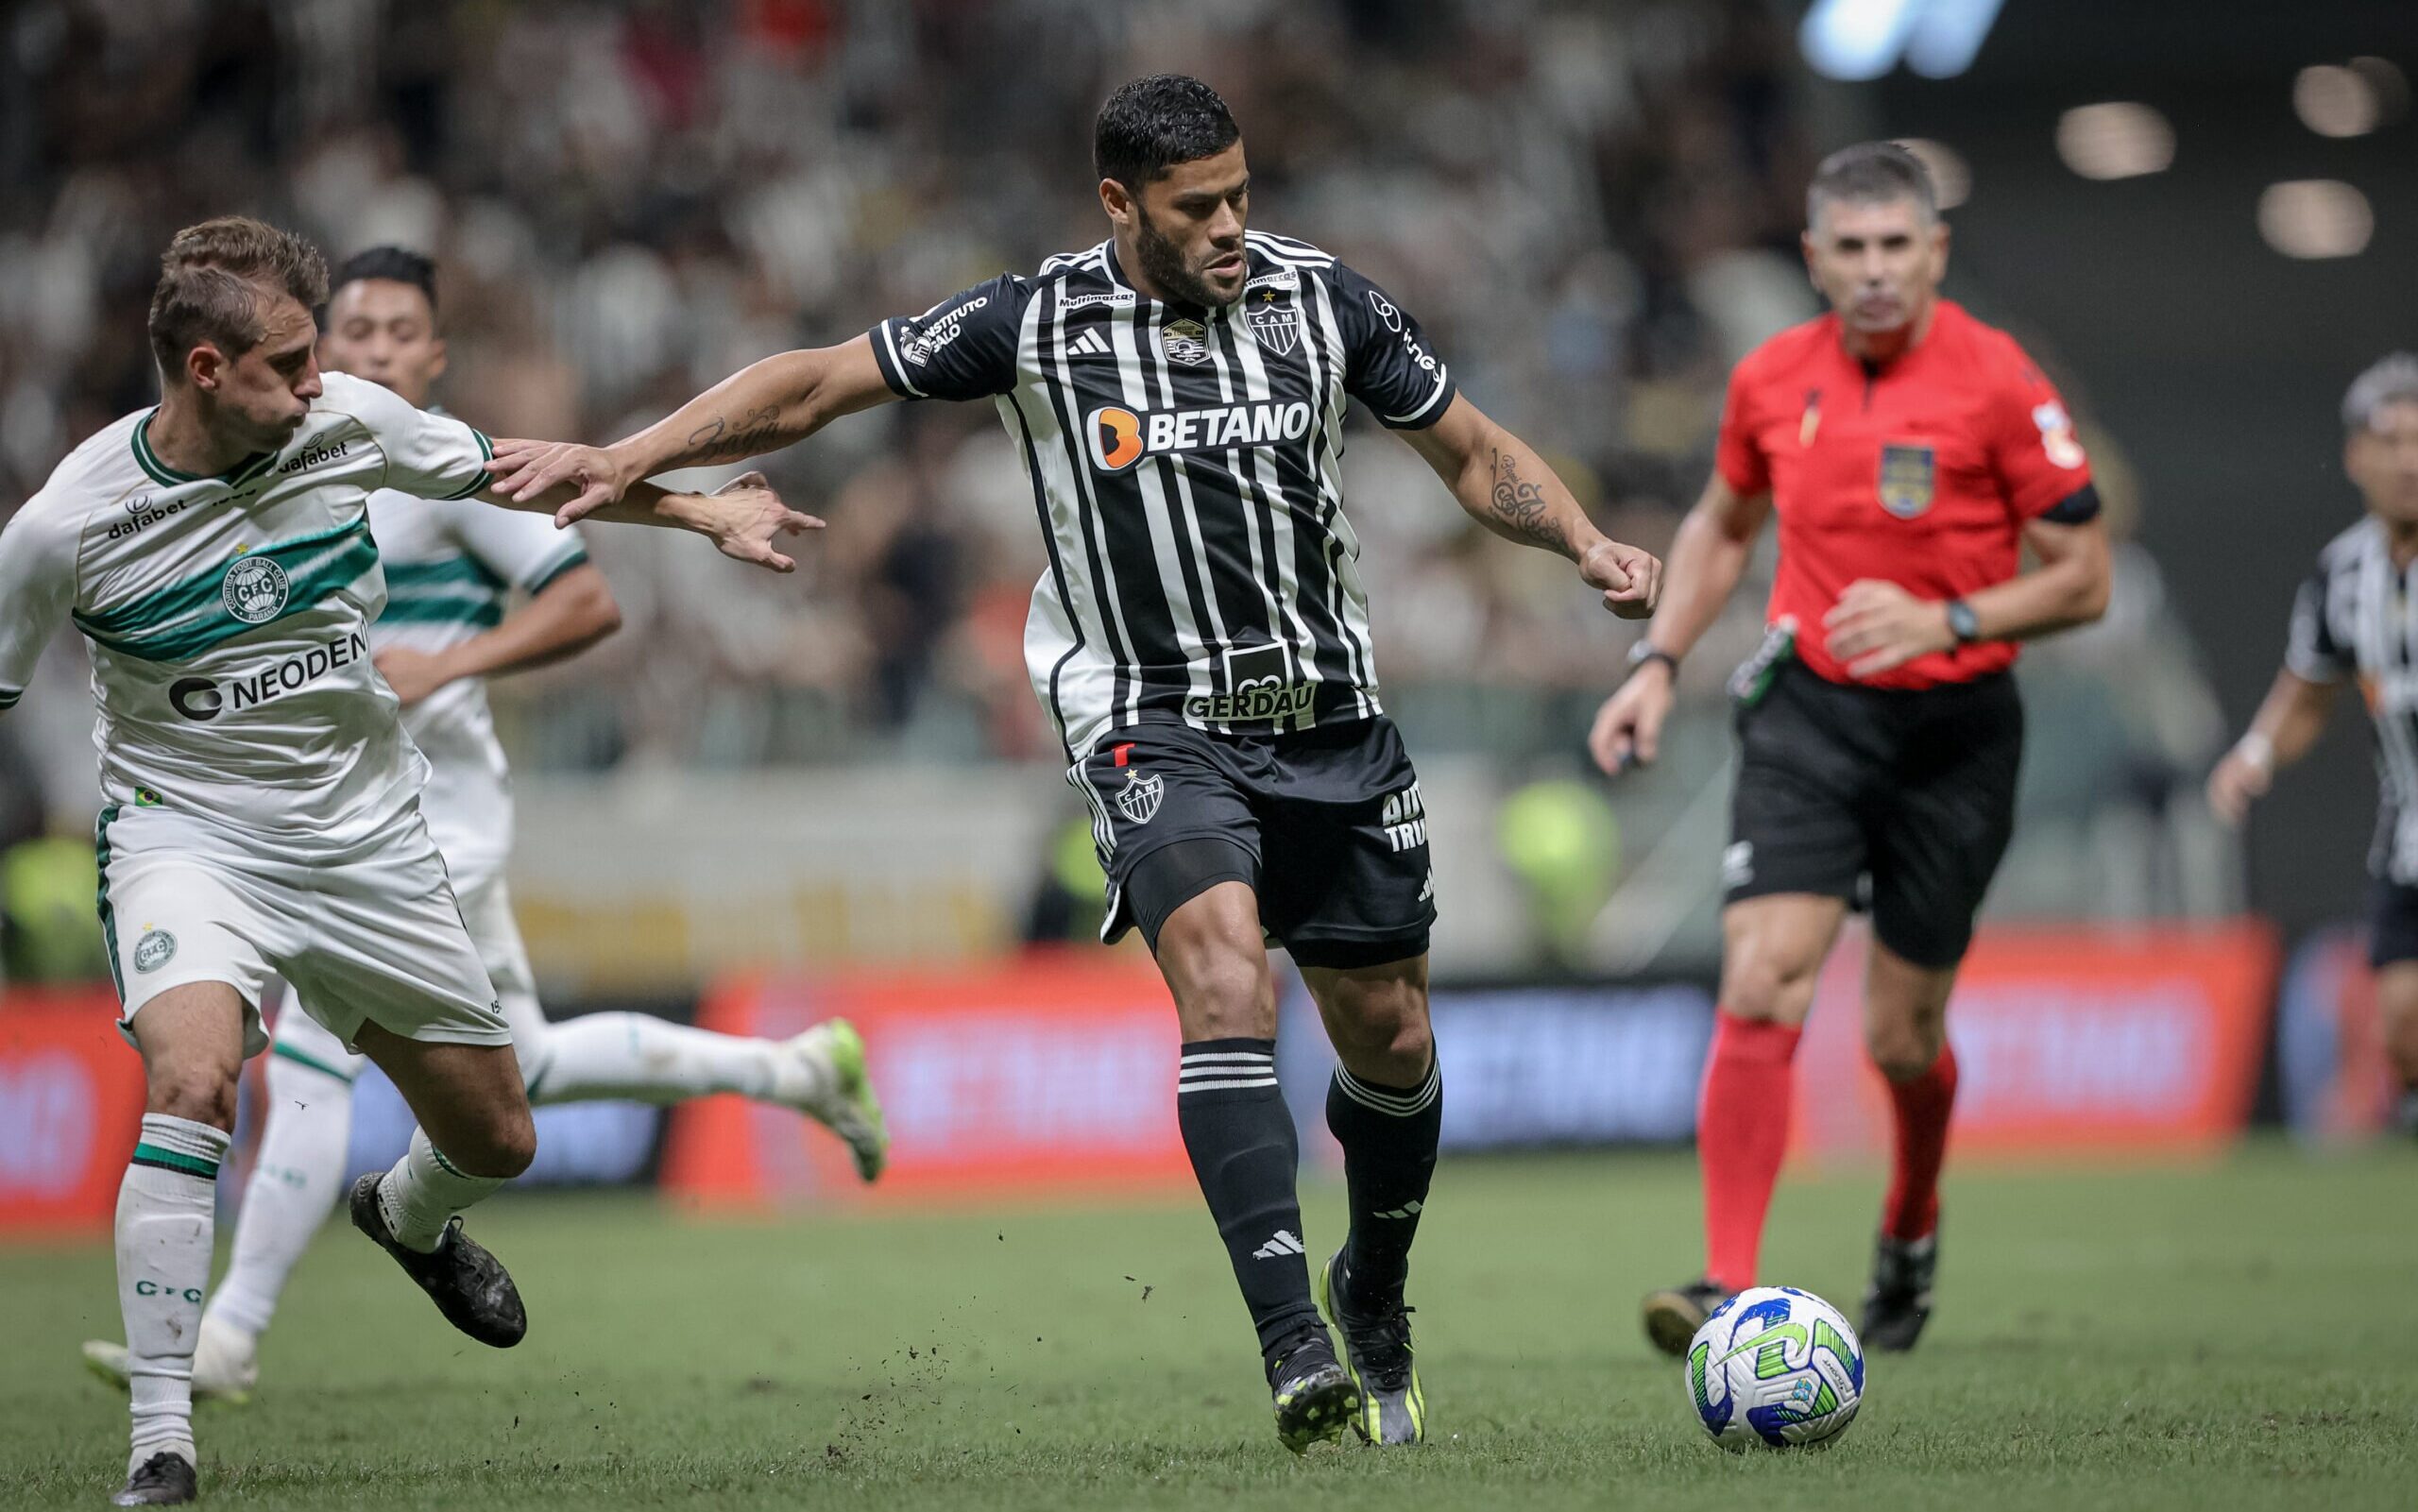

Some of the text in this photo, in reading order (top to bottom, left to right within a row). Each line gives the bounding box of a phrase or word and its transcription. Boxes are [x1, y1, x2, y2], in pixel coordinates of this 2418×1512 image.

[1060, 294, 1134, 307] Multimarcas
[1255, 314, 1293, 325] CAM
[1147, 401, 1311, 452] BETANO
[108, 499, 189, 540] dafabet
[255, 559, 275, 571] BALL
[273, 569, 287, 590] CLUB
[1185, 686, 1313, 718] GERDAU
[1124, 783, 1155, 802] CAM
